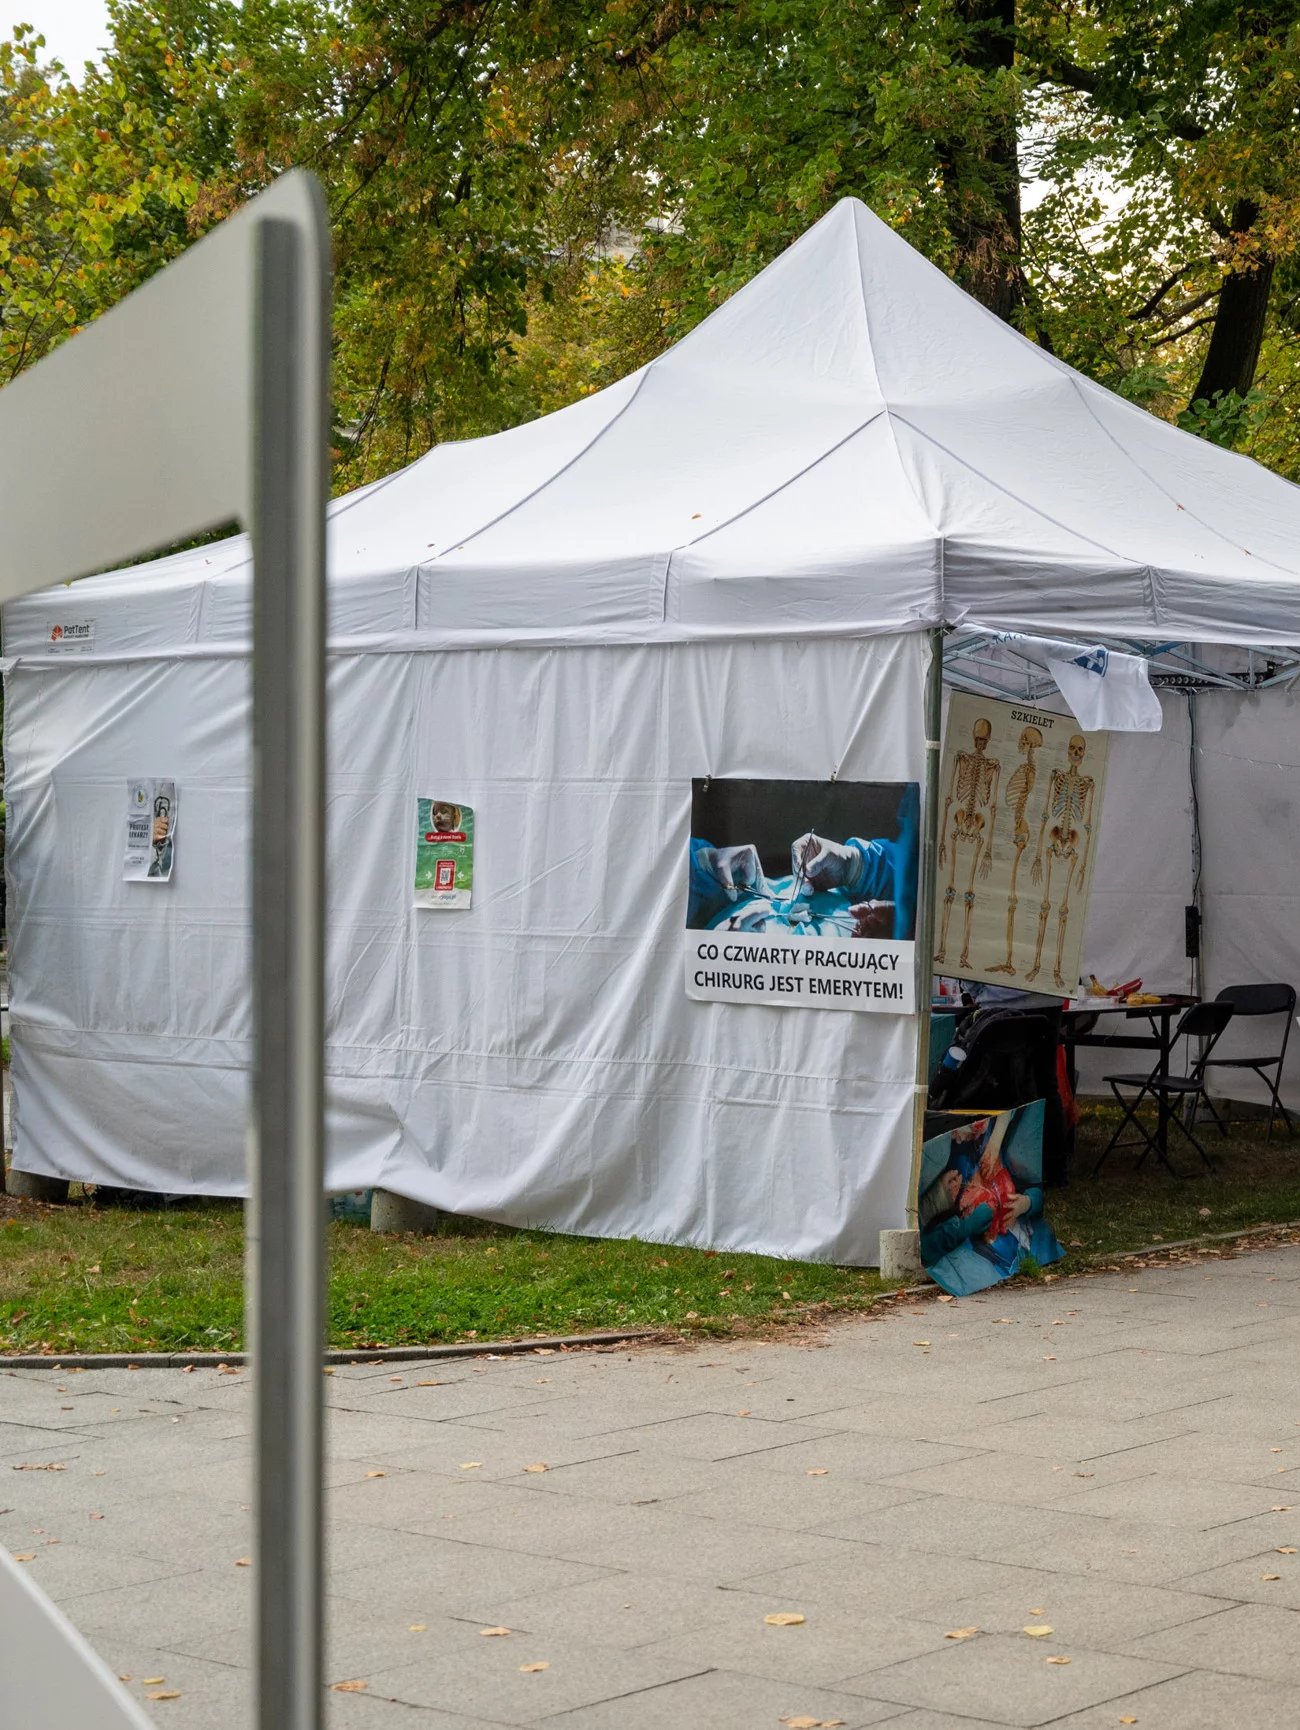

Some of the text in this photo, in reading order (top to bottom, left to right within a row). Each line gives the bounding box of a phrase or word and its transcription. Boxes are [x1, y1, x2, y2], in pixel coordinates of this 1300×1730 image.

[1010, 710, 1055, 729] SZKIELET
[697, 943, 899, 974] CO CZWARTY PRACUJĄCY
[694, 970, 904, 1000] CHIRURG JEST EMERYTEM!
